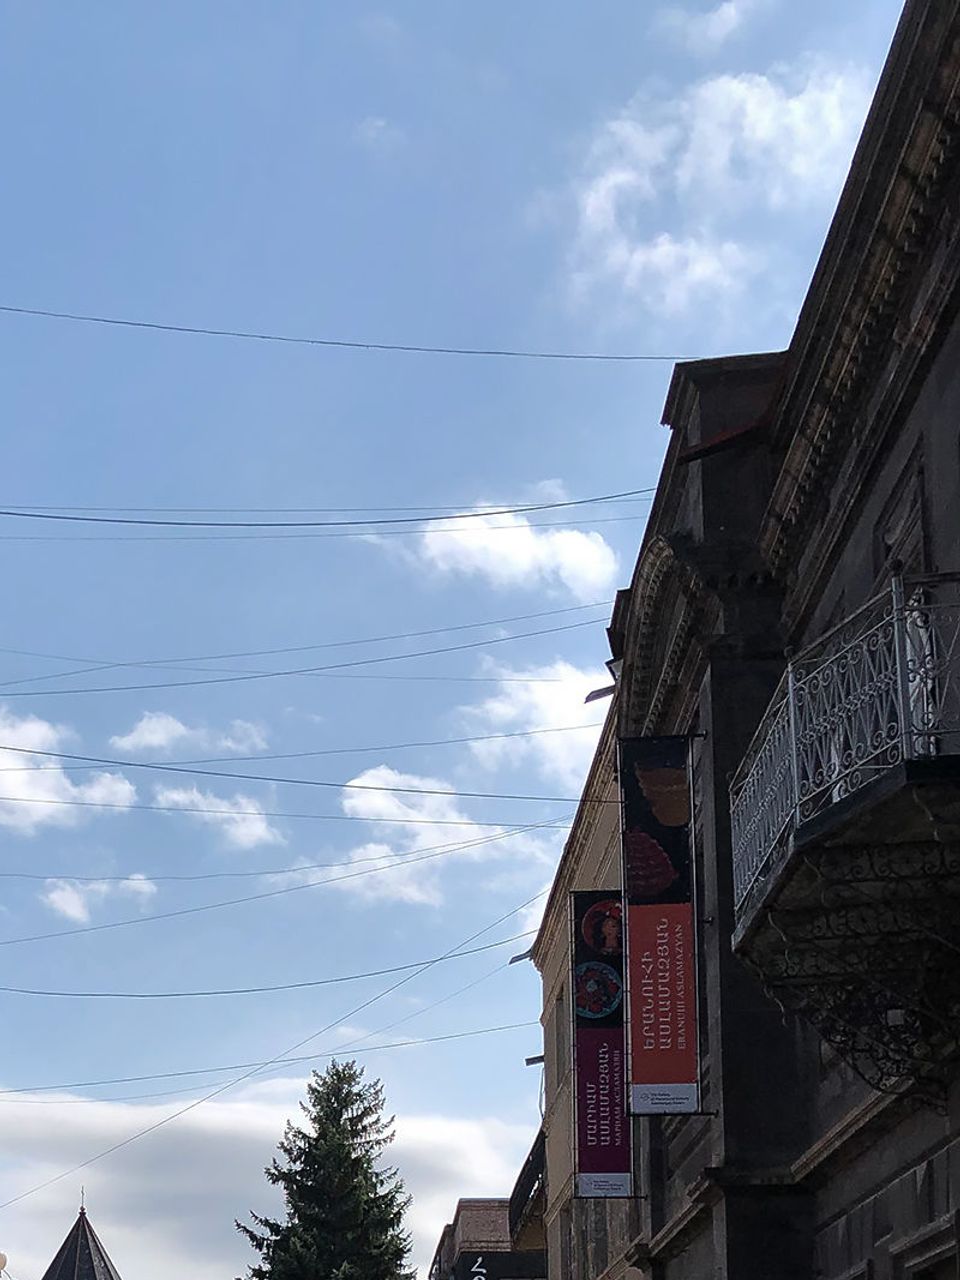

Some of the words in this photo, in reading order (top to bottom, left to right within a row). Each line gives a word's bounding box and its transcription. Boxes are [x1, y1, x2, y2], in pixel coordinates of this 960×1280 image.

[656, 917, 672, 1050] ԱՍԼԱՄԱԶՅԱՆ
[675, 923, 685, 998] ASLAMAZYAN
[641, 951, 655, 1050] ԵՐԱՆՈՒՀԻ
[677, 1001, 686, 1050] ERANUHI
[586, 1081, 598, 1146] ՄԱՐԻԱՄ
